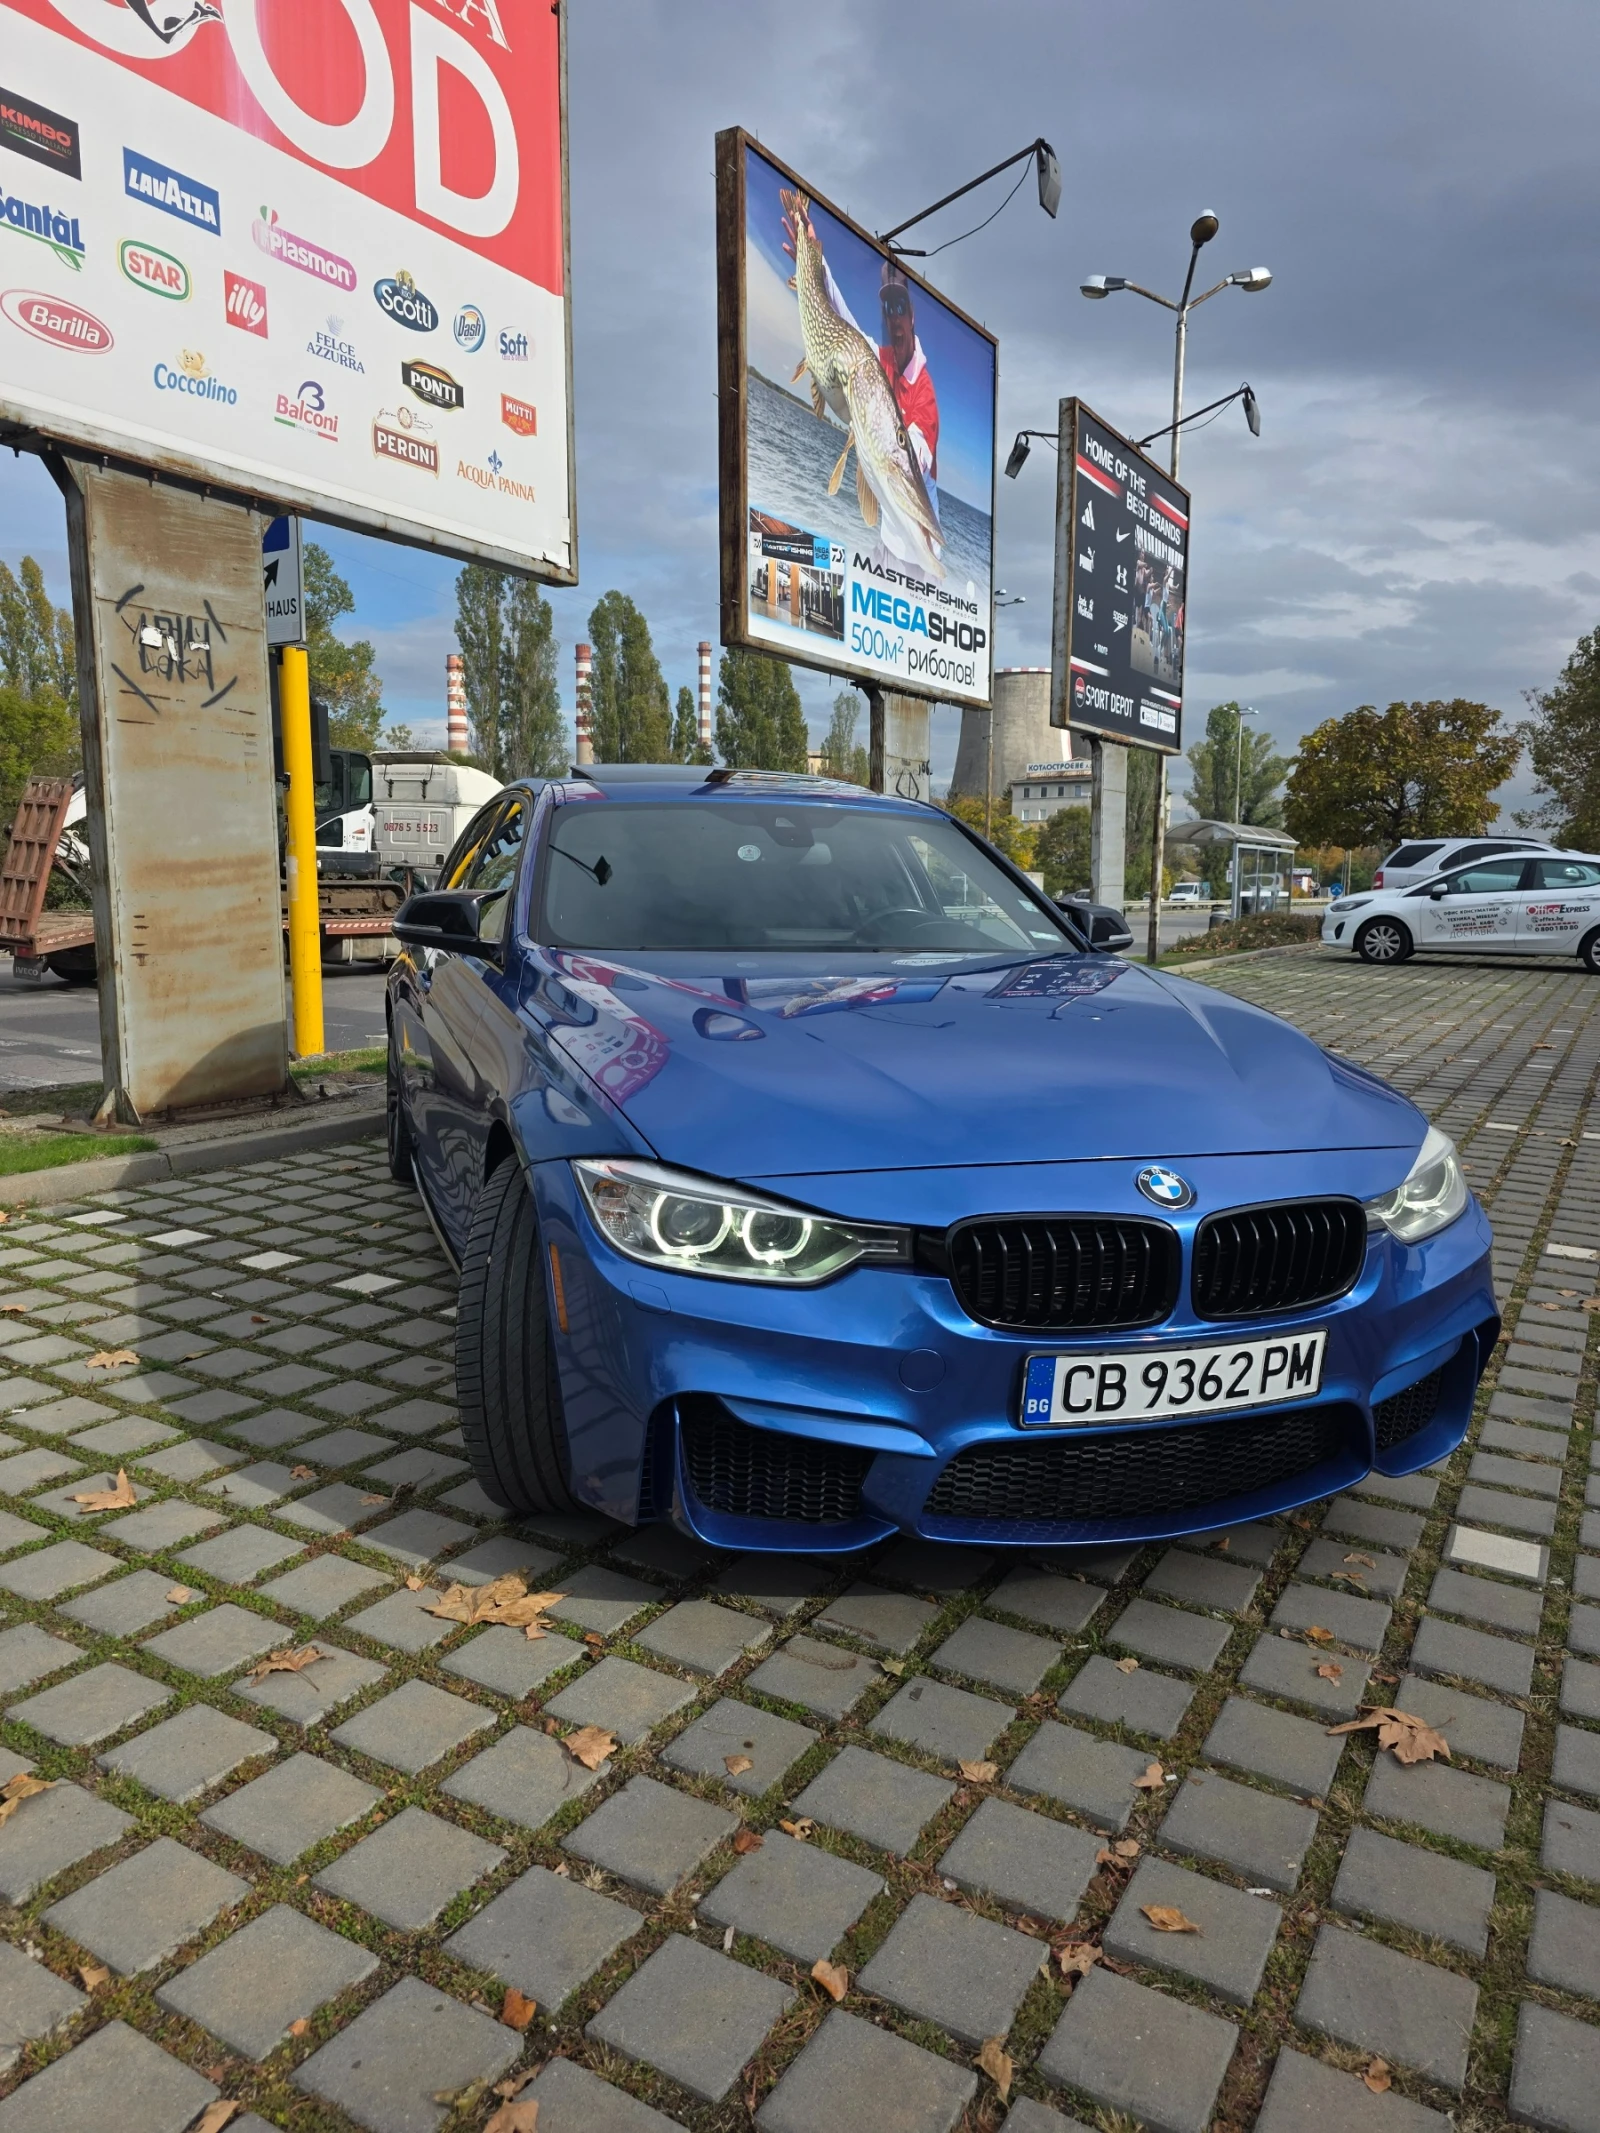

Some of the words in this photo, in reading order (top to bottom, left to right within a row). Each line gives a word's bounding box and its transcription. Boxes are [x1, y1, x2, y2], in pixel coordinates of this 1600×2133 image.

[1, 104, 72, 147] KIMBO
[38, 134, 73, 156] ITALIANO
[128, 168, 218, 227] LAVAZZA
[128, 250, 182, 291] STAR
[270, 231, 351, 287] Plasmon
[227, 283, 265, 327] illy
[381, 284, 432, 330] Scotti
[29, 304, 101, 345] Barilla
[458, 315, 482, 337] Dash
[306, 342, 365, 374] AZZURRA
[316, 331, 356, 358] FELCE
[500, 332, 528, 356] Soft
[153, 363, 238, 405] Coccolino
[410, 370, 456, 403] PONTI
[276, 394, 339, 433] Balconi
[505, 401, 533, 421] MUTTI
[377, 430, 435, 467] PERONI
[1085, 433, 1114, 473] HOME
[1114, 458, 1128, 481] OF
[1129, 468, 1147, 497] THE
[457, 460, 496, 490] ACQUA
[498, 476, 536, 503] PANNA
[1126, 490, 1149, 521] BEST
[1149, 506, 1181, 545] BRANDS
[265, 598, 298, 618] HAUS
[908, 647, 975, 687] риболов!
[1085, 684, 1110, 711] SPORT
[1110, 692, 1135, 718] DEPOT
[1450, 927, 1499, 939] ДОСТАВКА
[15, 966, 39, 977] IVECO
[1140, 1166, 1181, 1183] BMW
[1061, 1363, 1127, 1414] CB
[1141, 1351, 1254, 1410] 9362
[1259, 1339, 1318, 1395] PM
[1026, 1399, 1049, 1414] BG
